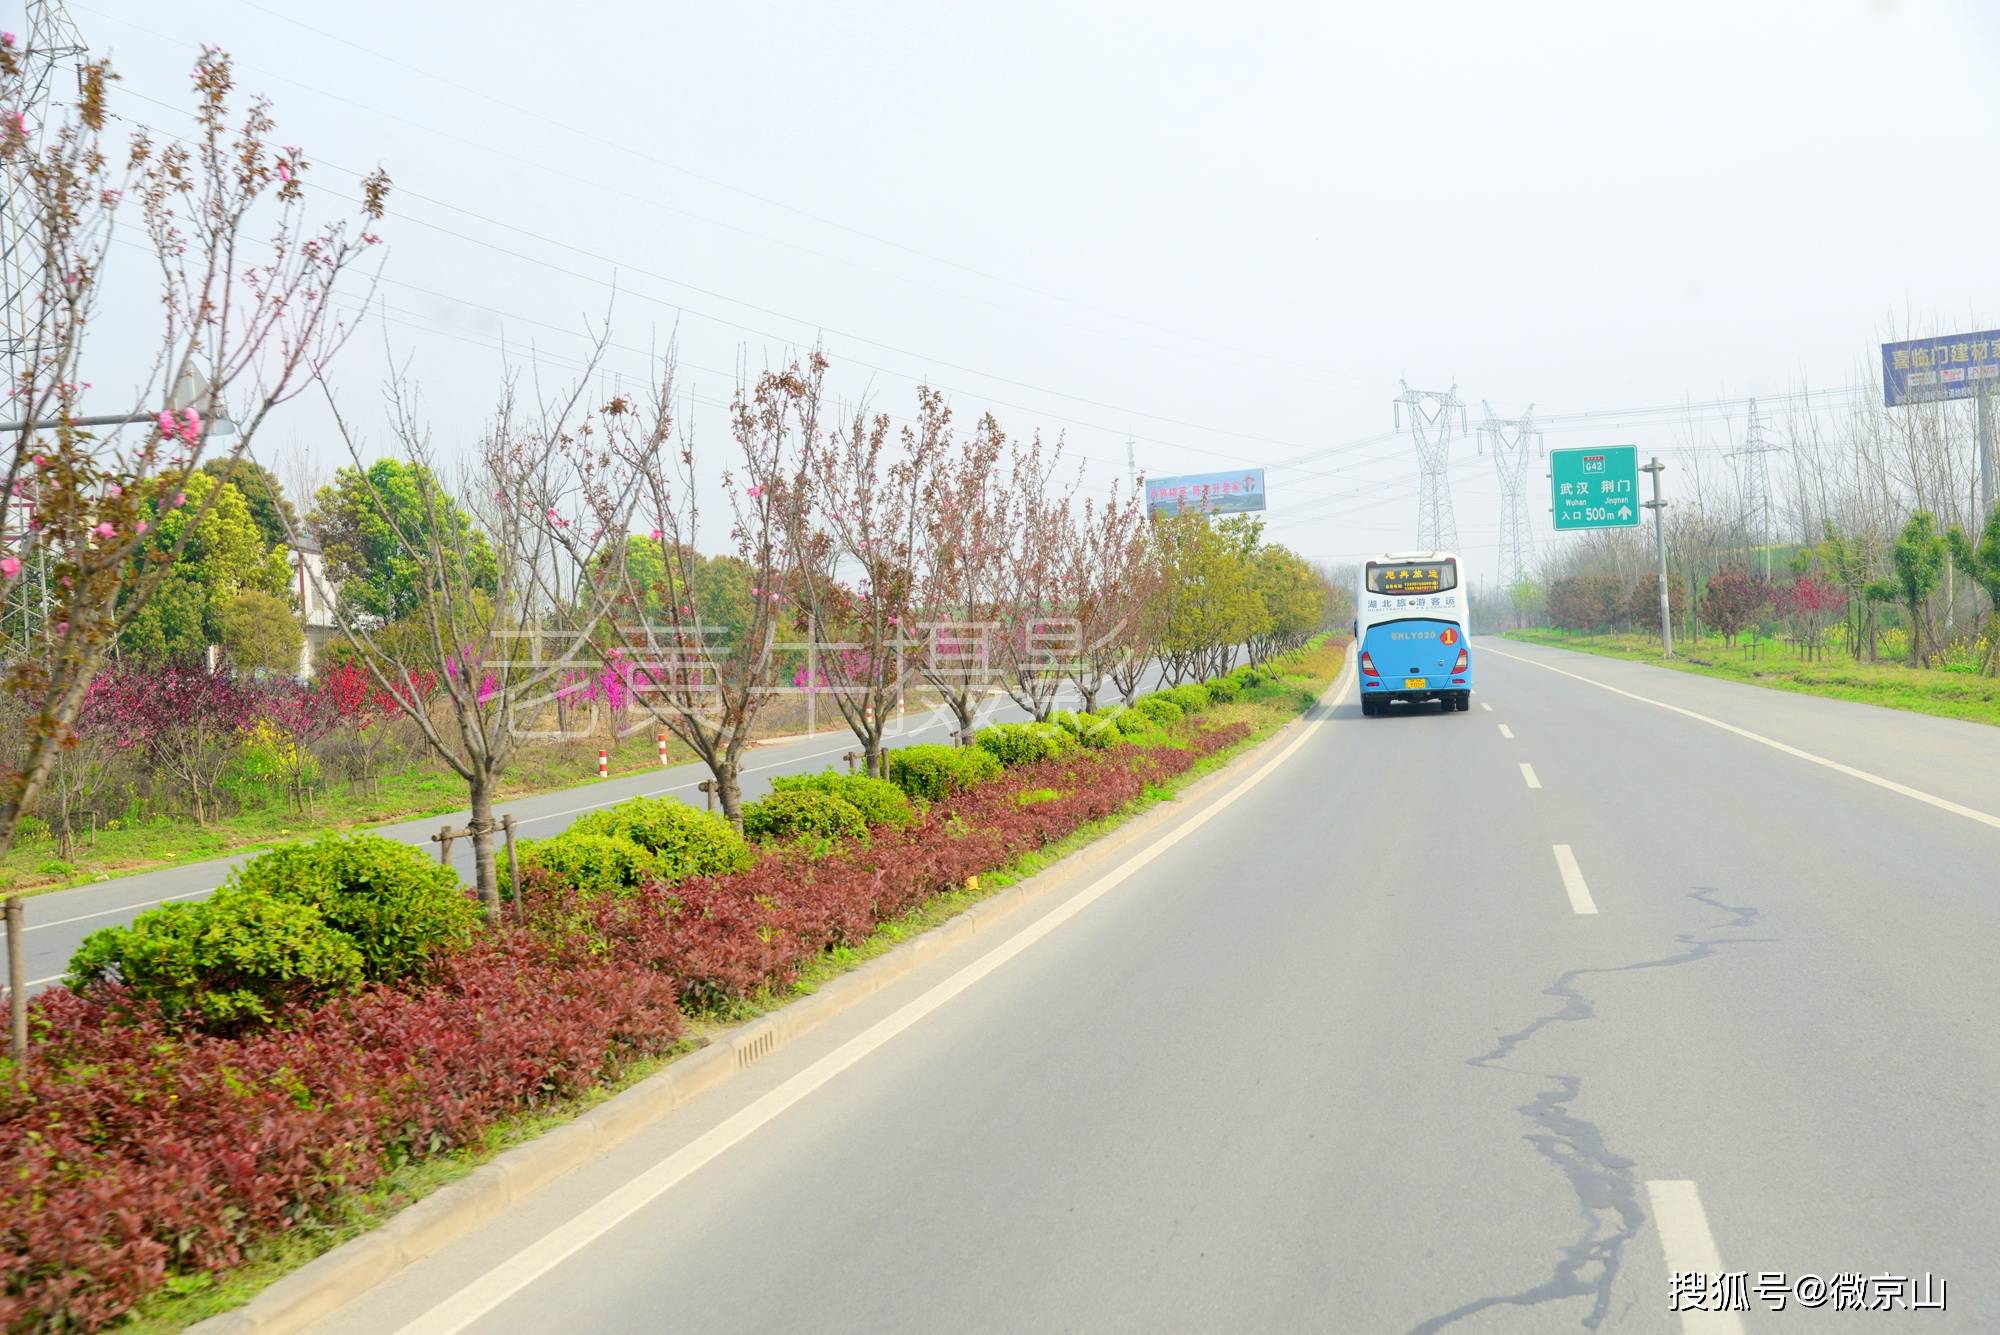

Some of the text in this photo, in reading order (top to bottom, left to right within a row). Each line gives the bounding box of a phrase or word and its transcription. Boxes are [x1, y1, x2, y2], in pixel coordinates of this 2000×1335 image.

[1586, 462, 1603, 471] G42
[1560, 479, 1631, 495] 武汉 荆门
[1566, 497, 1629, 507] Wuhan Jingmen
[1562, 511, 1581, 520] 入口
[1444, 629, 1453, 644] 1
